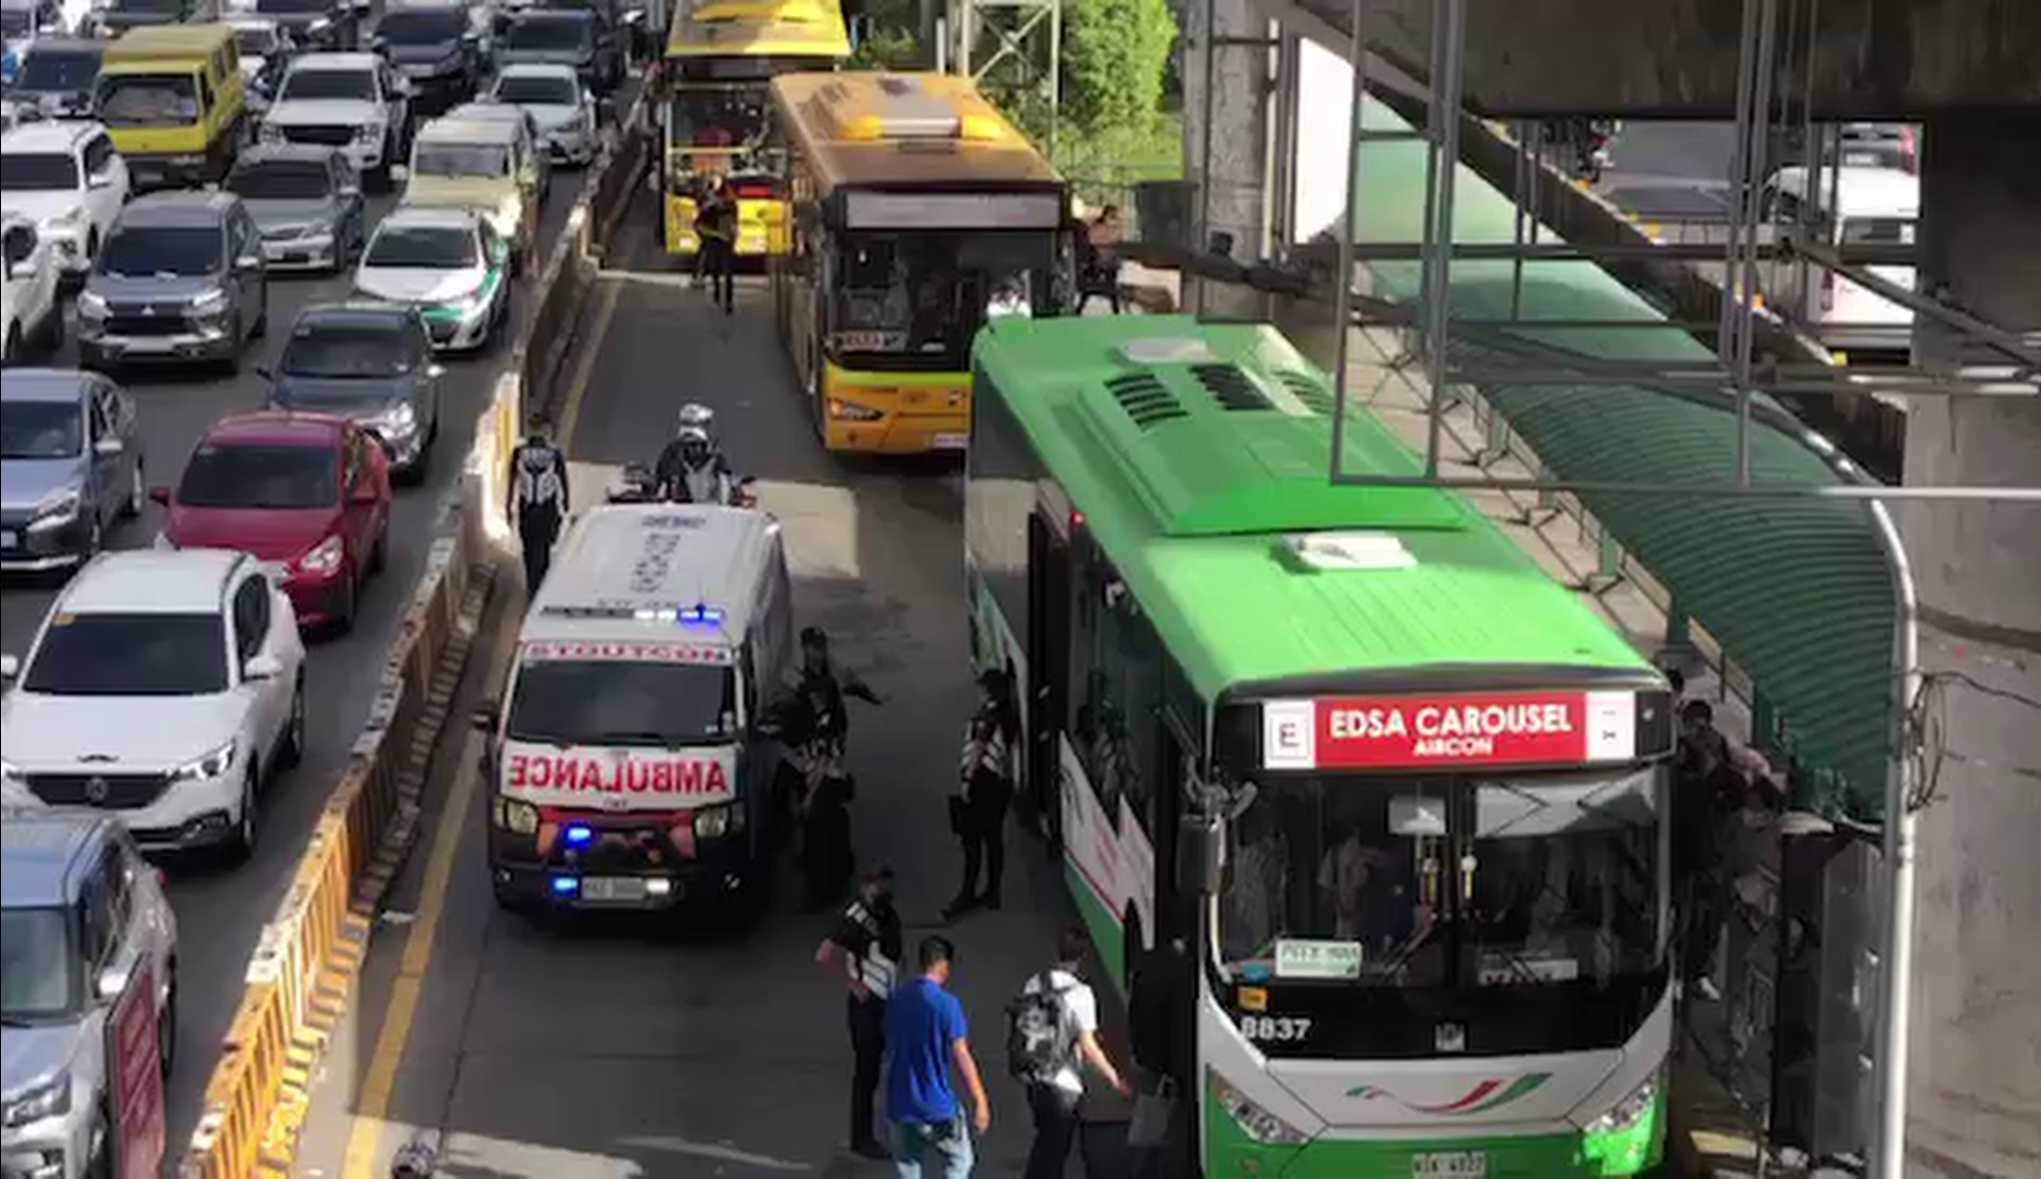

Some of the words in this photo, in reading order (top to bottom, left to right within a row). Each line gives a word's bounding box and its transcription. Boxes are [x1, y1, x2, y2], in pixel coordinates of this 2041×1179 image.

[1330, 709, 1407, 738] EDSA
[1415, 704, 1573, 736] CAROUSEL
[1413, 737, 1494, 756] AIRCON
